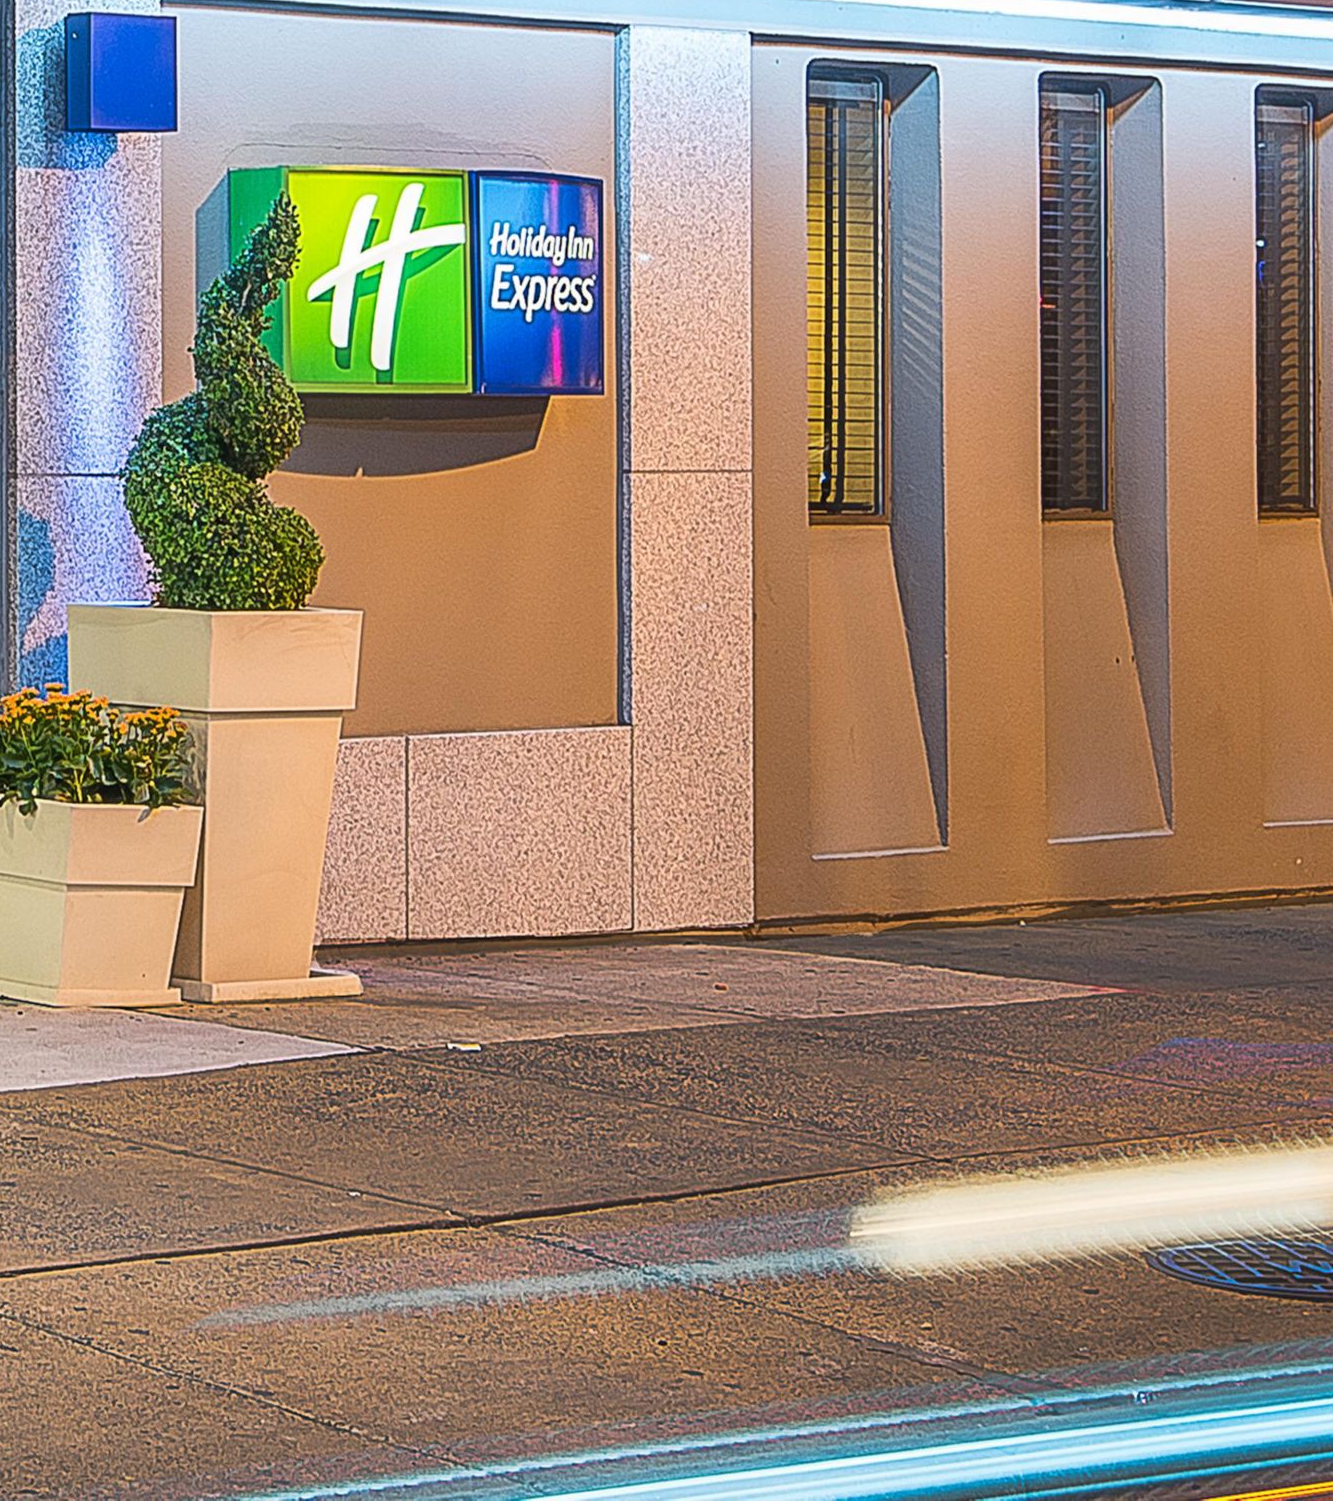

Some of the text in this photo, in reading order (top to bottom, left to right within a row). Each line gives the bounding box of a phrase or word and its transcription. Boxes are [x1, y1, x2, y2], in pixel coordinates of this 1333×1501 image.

[489, 222, 594, 267] Holiday Inn
[490, 263, 596, 323] Express
